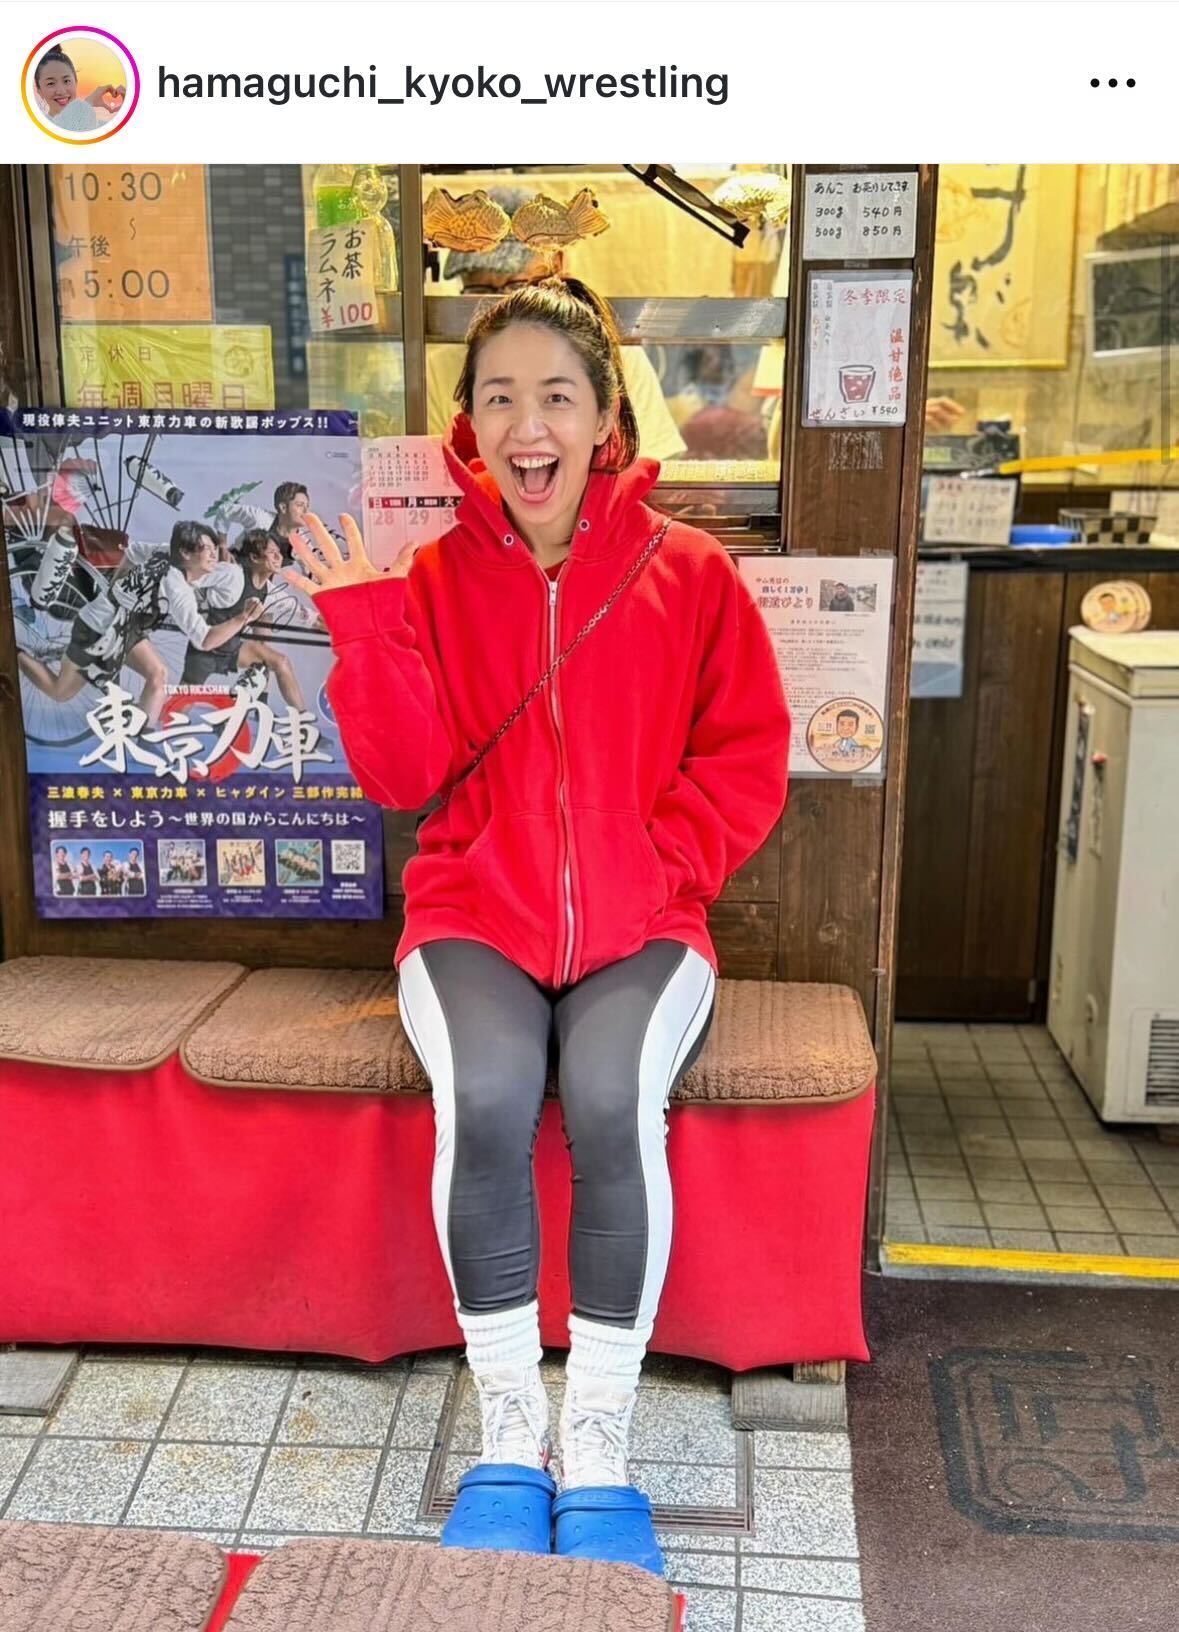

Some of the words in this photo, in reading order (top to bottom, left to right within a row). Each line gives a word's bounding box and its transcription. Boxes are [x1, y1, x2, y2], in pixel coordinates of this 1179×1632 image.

[65, 172, 161, 201] 10:30
[814, 182, 843, 195] あんこ
[815, 206, 843, 219] 300g
[815, 226, 842, 239] 500g
[66, 234, 112, 259] 午後
[342, 228, 365, 279] お茶
[317, 233, 337, 303] ラムネ
[84, 269, 169, 299] 5:00
[844, 288, 907, 305] 冬季限定
[321, 302, 372, 328] ¥100
[80, 346, 151, 361] 定休日
[374, 510, 394, 525] 28
[409, 510, 429, 525] 29
[79, 680, 335, 784] 東京力車
[131, 786, 188, 800] 東京力車
[216, 785, 285, 799] ヒャダイン
